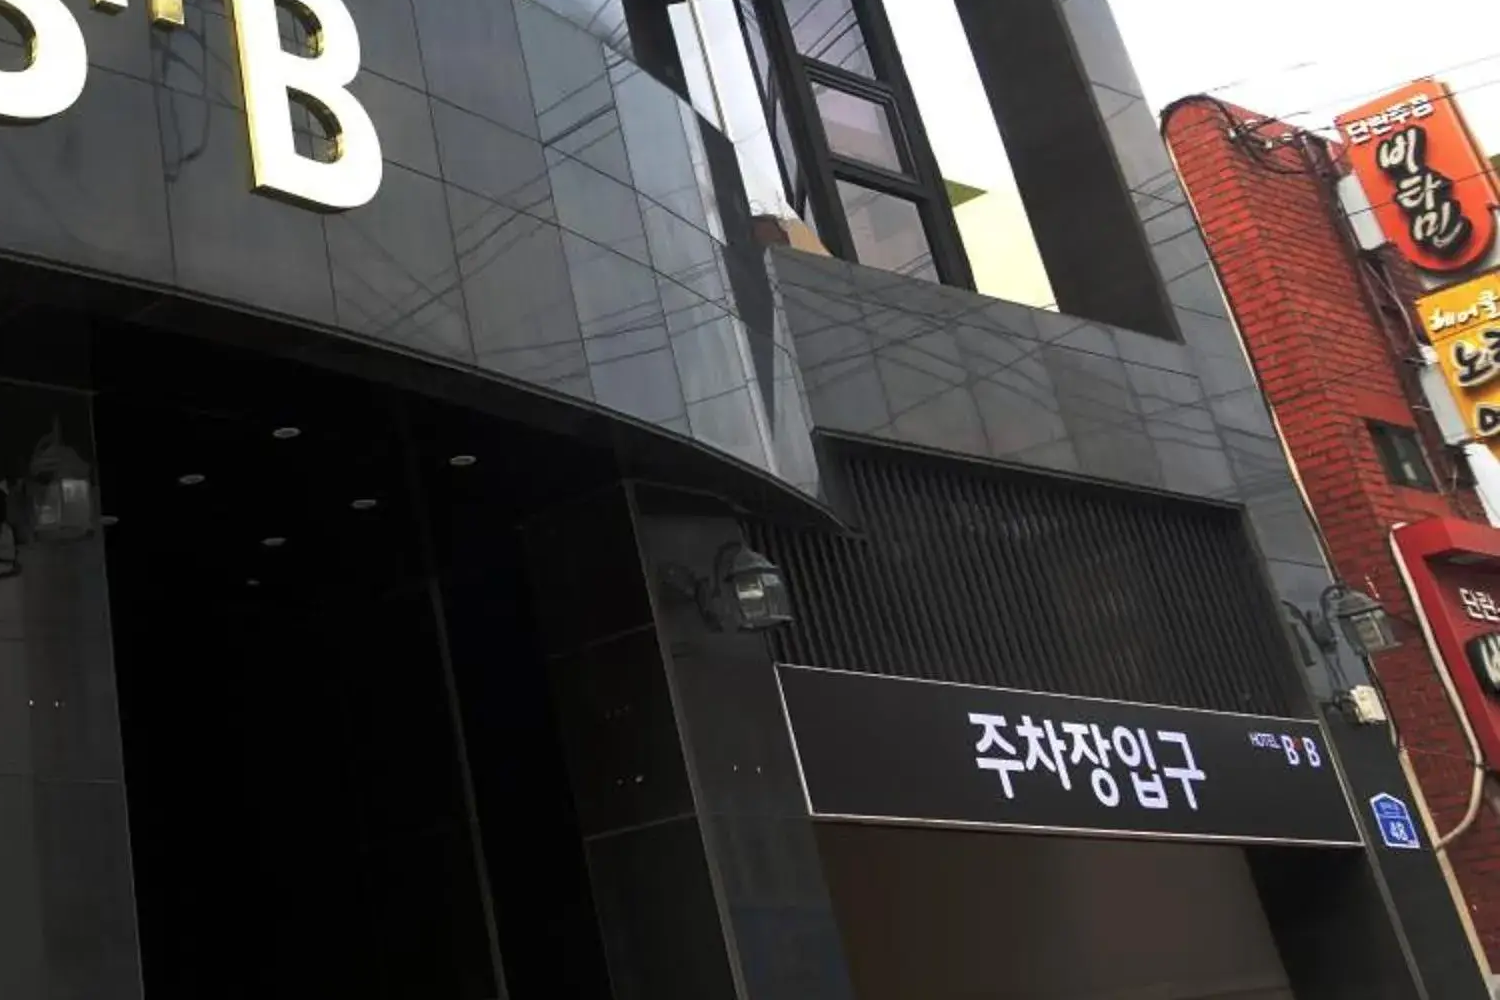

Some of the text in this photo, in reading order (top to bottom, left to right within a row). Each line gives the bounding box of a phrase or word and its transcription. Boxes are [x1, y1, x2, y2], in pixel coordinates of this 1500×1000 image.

[1378, 128, 1466, 249] 비타민
[967, 711, 1207, 811] 주차장입구
[1248, 731, 1282, 750] HOTEL
